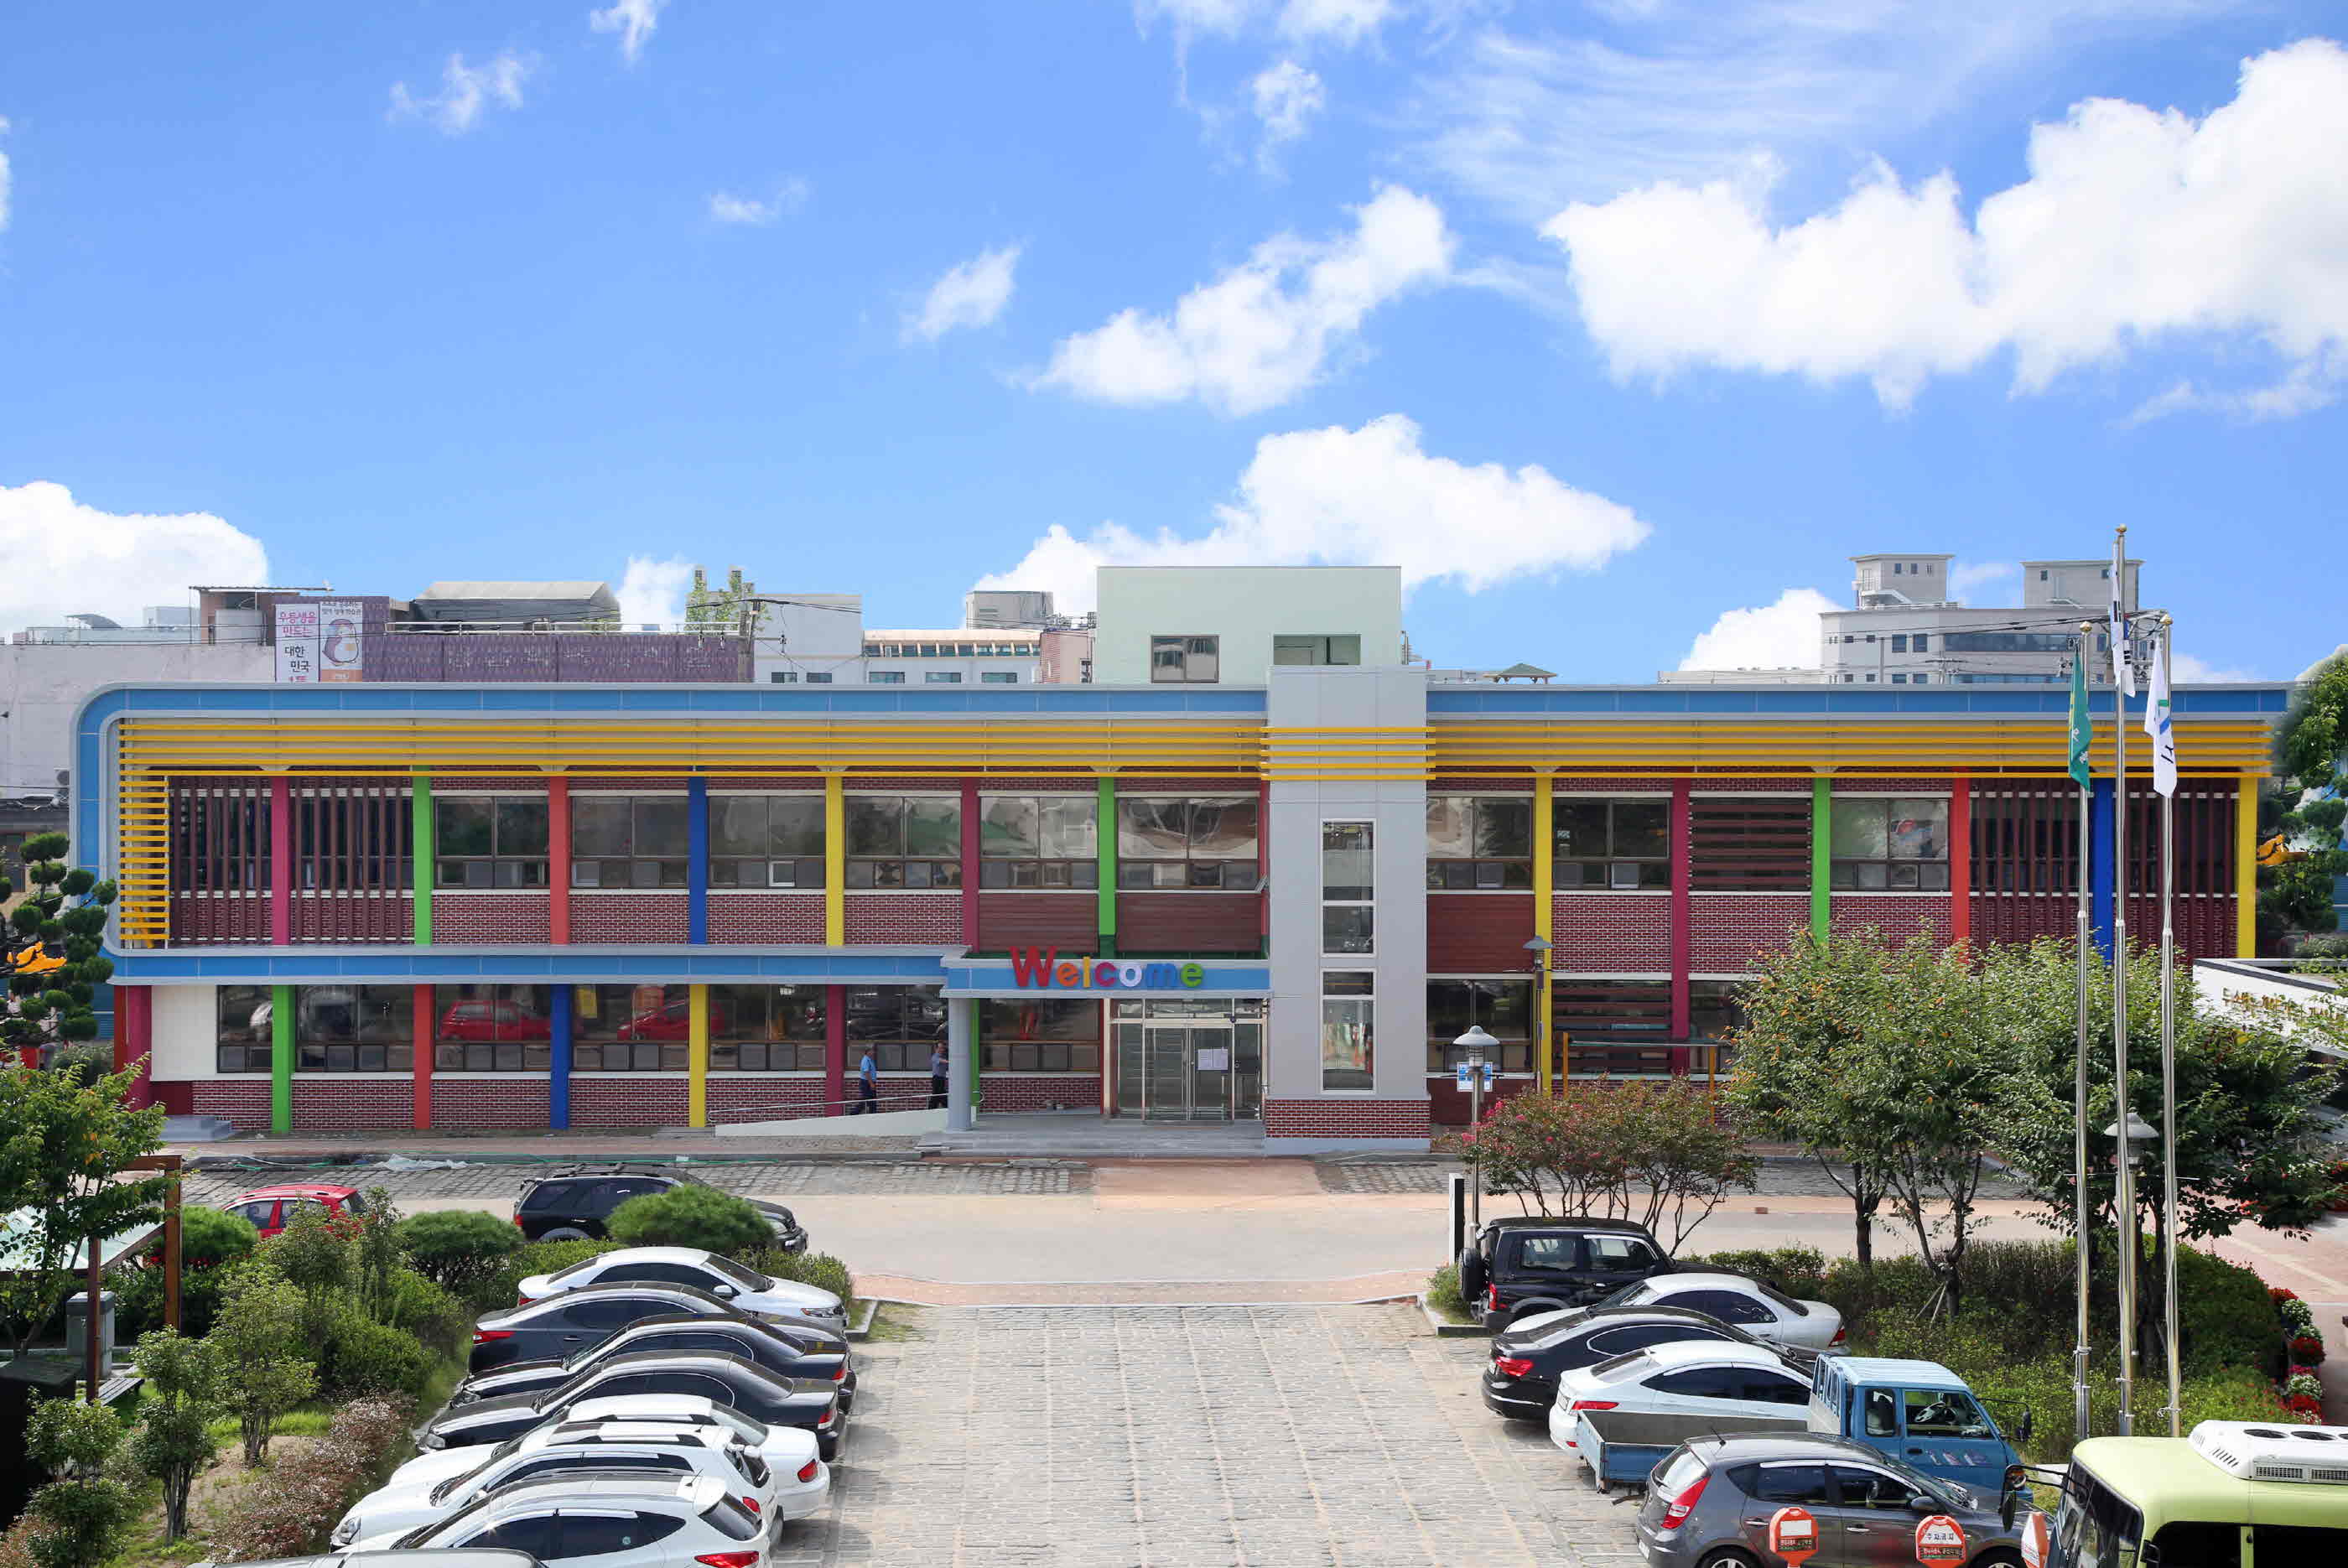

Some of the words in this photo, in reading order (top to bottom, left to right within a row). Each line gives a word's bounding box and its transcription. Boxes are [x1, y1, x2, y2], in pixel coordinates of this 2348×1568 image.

[278, 611, 317, 624] 우등생을
[282, 626, 313, 638] 만드는
[284, 646, 305, 657] 대한
[290, 661, 310, 672] 민국
[1009, 946, 1204, 989] Welcome
